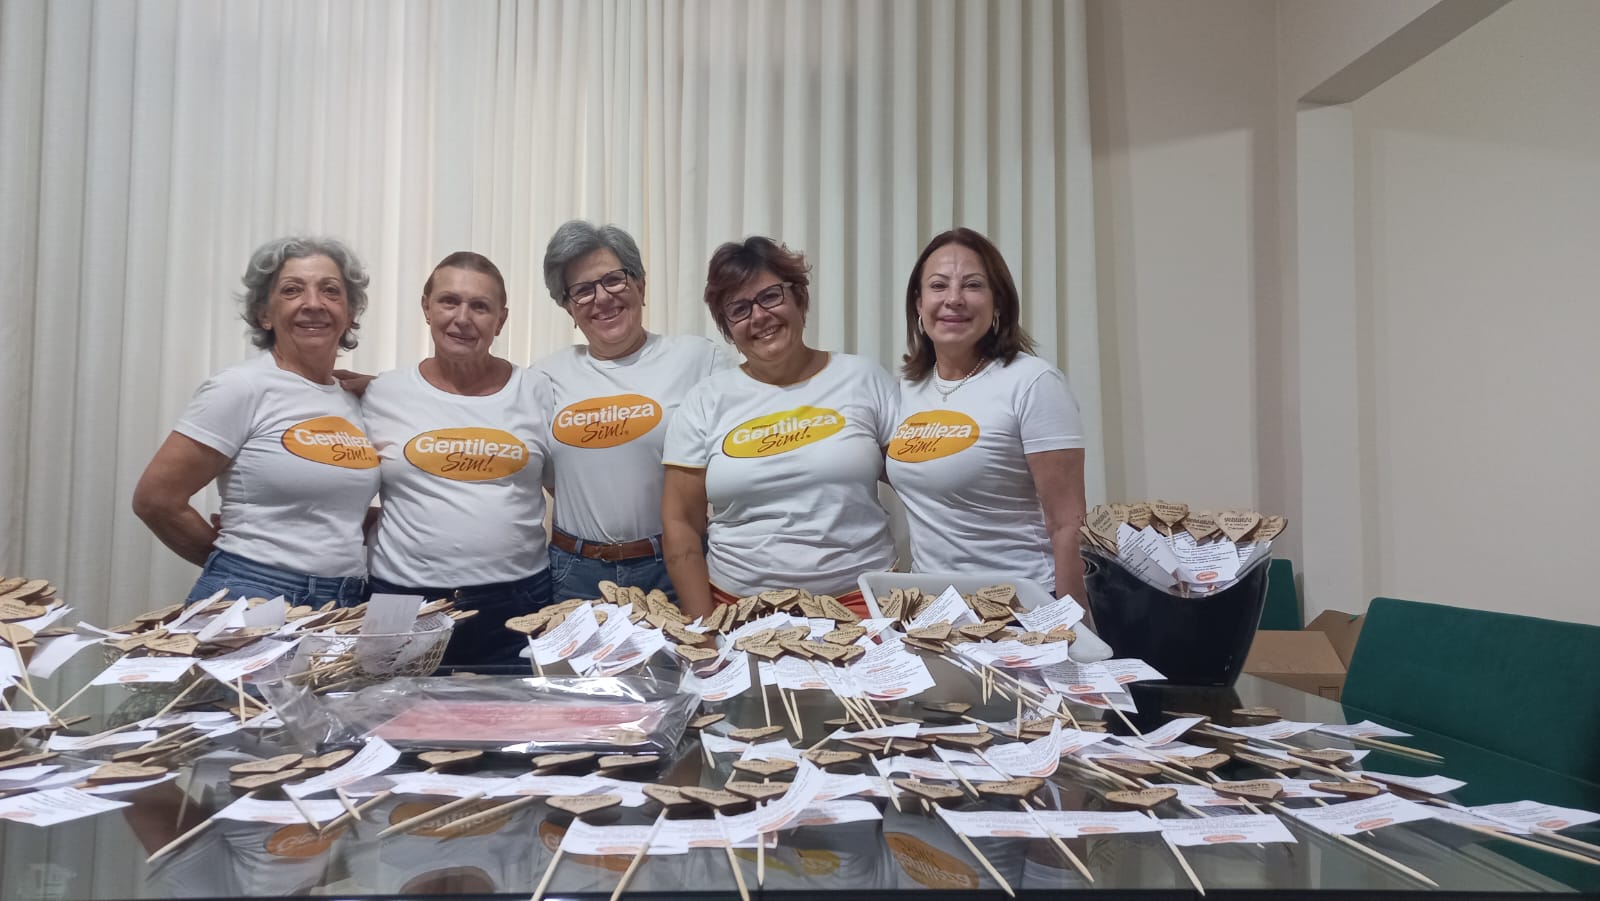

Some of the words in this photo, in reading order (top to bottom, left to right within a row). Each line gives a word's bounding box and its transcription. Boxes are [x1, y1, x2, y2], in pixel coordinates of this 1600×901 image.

[557, 403, 655, 428] Gentileza
[732, 414, 838, 445] Gentileza
[894, 422, 972, 440] Gentileza
[415, 436, 523, 460] Gentileza
